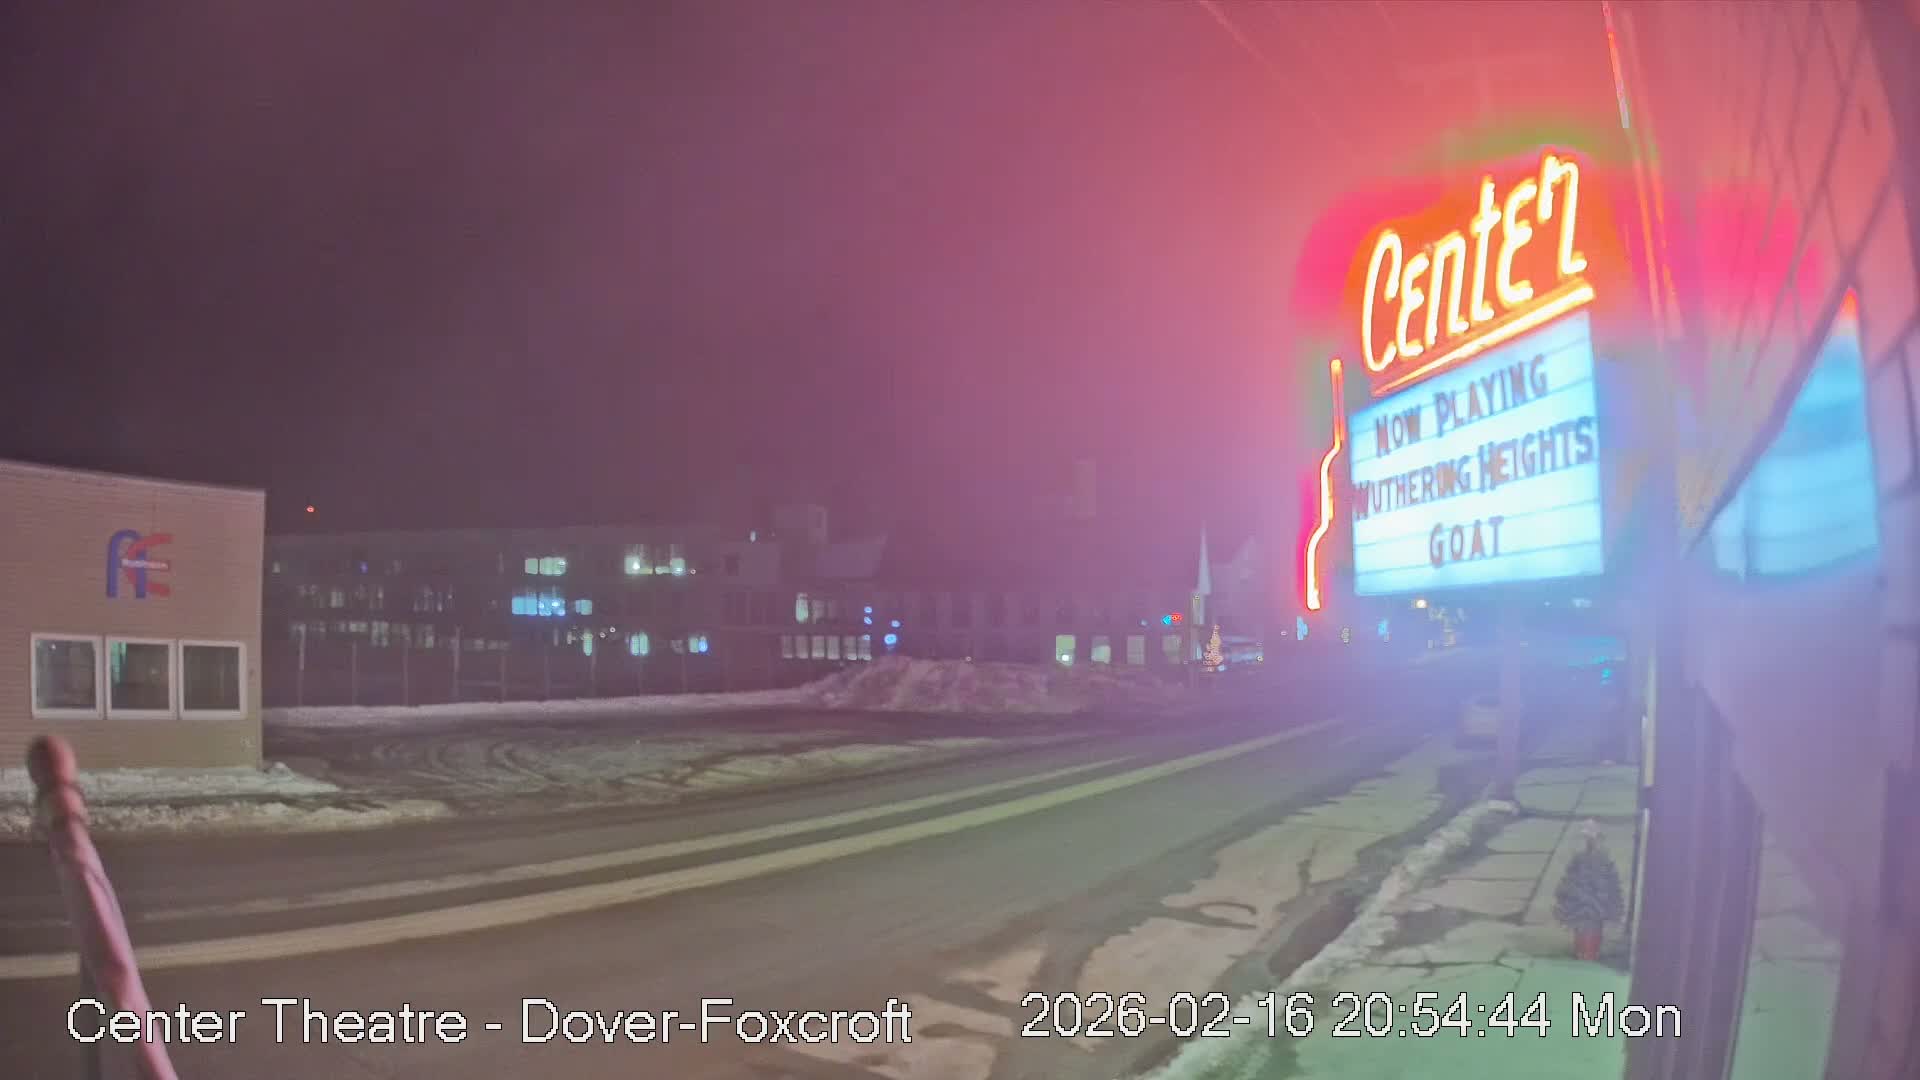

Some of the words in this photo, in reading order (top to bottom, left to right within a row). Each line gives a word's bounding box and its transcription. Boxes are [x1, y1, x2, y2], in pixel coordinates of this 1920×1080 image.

[1362, 154, 1588, 372] Center
[1375, 405, 1422, 458] NOW
[1434, 354, 1549, 438] PLAYING
[1352, 455, 1472, 520] WUTHERING
[1478, 416, 1595, 493] HEIGHTS
[1430, 515, 1505, 569] GOAT
